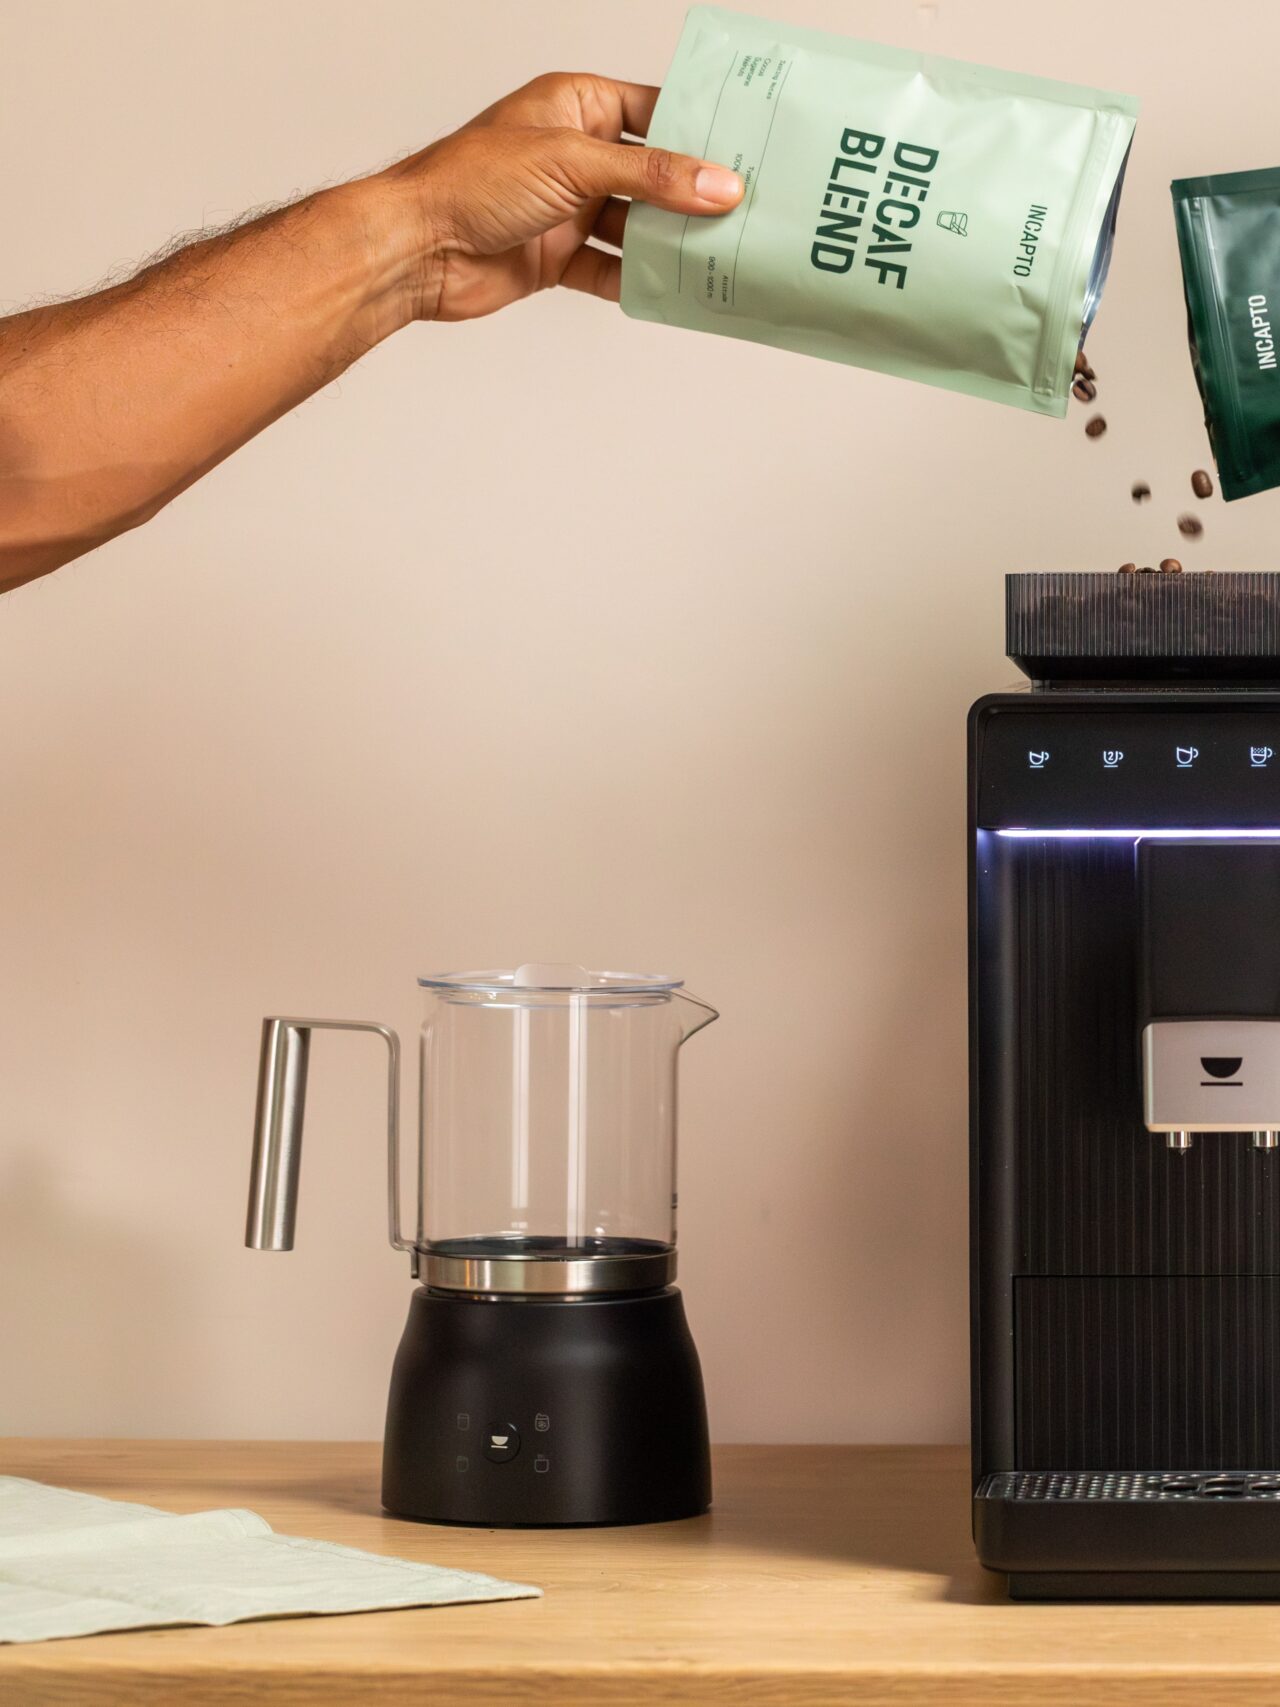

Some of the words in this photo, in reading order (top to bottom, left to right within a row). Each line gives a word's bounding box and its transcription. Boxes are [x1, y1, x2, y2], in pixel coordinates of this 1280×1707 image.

[810, 127, 886, 274] BLEND
[864, 141, 940, 290] DECAF
[1013, 204, 1048, 277] INCAPTO
[1248, 294, 1278, 370] INCAPTO
